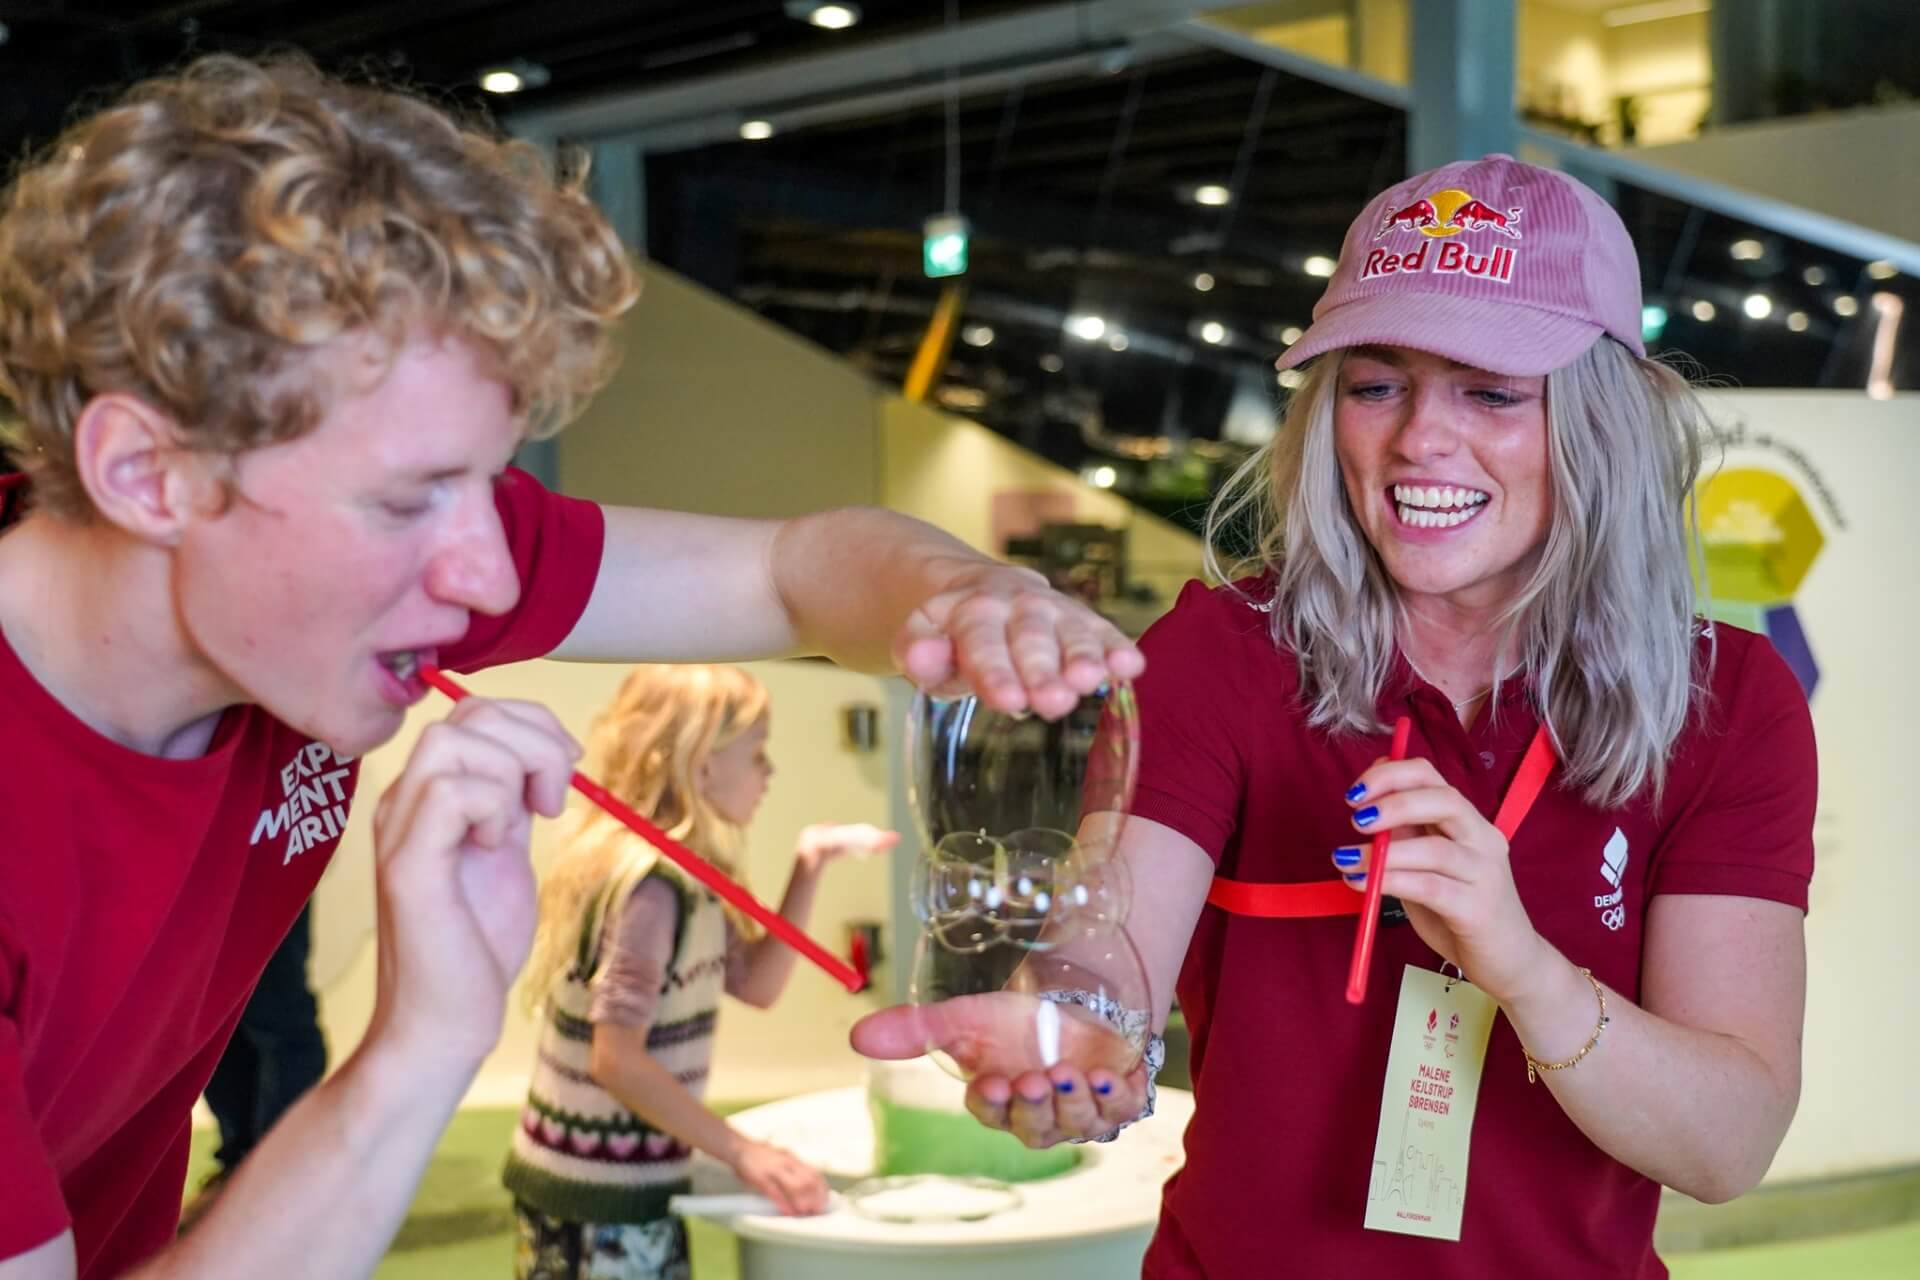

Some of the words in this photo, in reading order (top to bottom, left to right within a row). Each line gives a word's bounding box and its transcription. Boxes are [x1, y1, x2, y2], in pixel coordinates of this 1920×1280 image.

[1361, 240, 1431, 279] Red
[1435, 241, 1515, 282] Bull
[250, 768, 350, 845] MENT
[1418, 1063, 1451, 1083] MALENE
[1410, 1079, 1454, 1099] KEJLSTRUP
[1408, 1095, 1450, 1116] SØRENSEN
